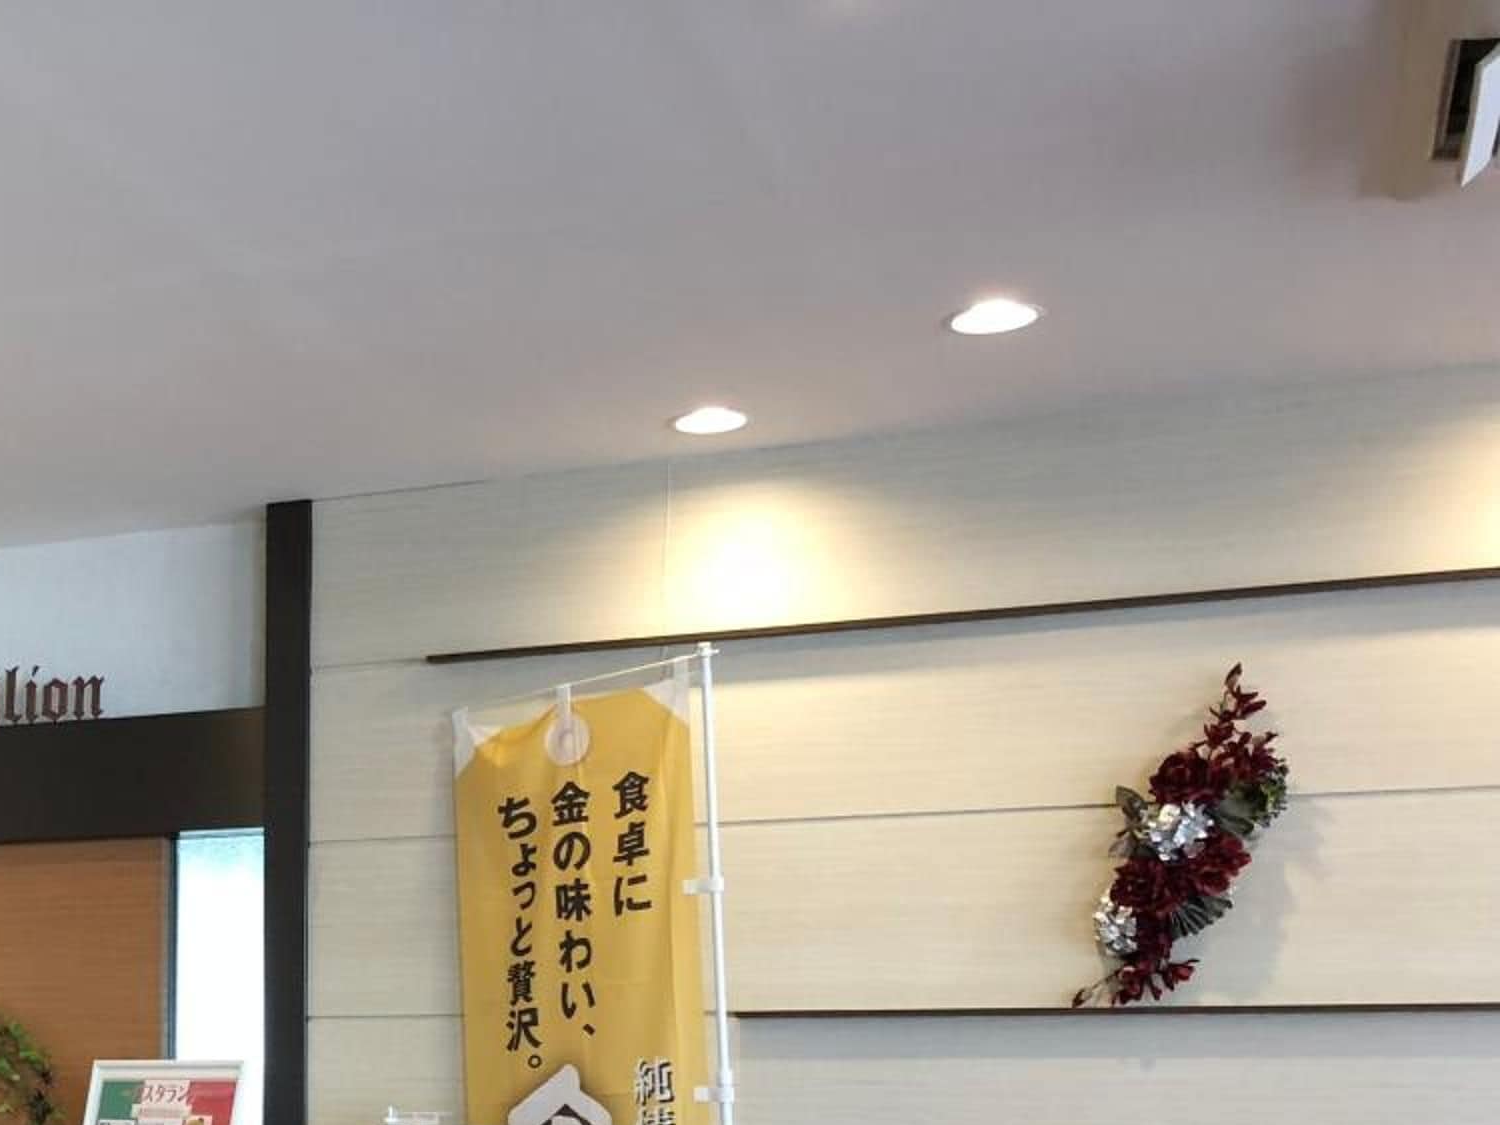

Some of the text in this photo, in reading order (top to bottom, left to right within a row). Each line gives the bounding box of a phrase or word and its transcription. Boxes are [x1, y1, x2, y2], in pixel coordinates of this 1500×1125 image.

[497, 796, 543, 1070] ちょっと贅沢。
[550, 780, 596, 1037] 金の味わい、
[611, 770, 653, 917] 食卓に
